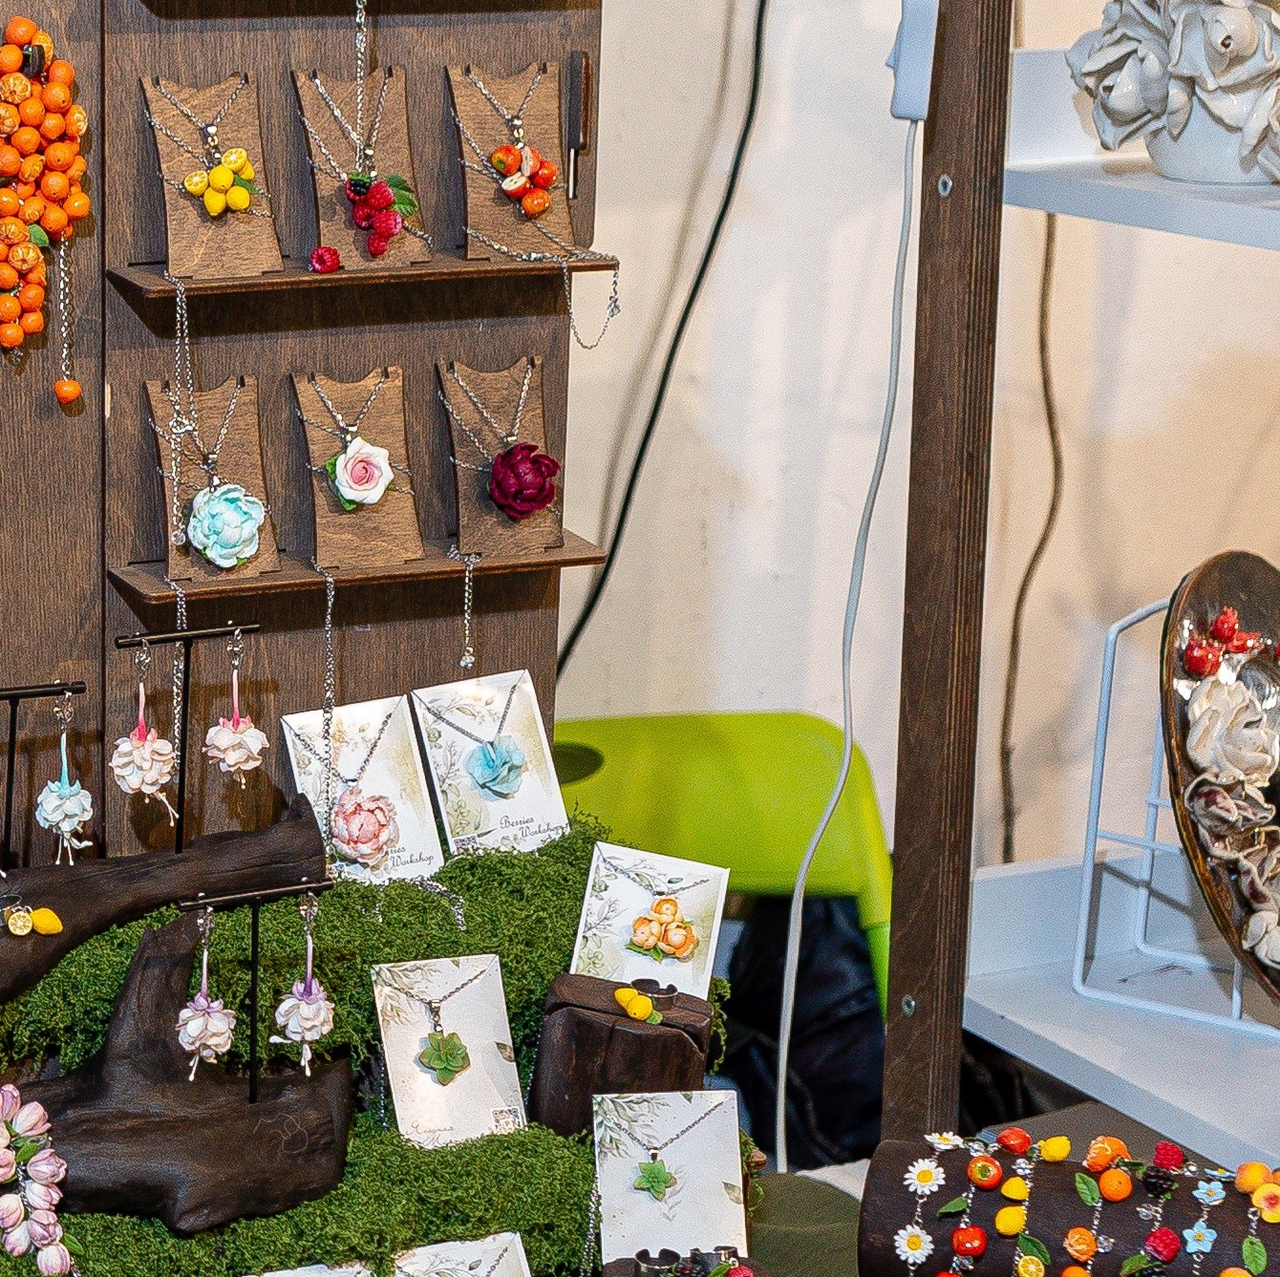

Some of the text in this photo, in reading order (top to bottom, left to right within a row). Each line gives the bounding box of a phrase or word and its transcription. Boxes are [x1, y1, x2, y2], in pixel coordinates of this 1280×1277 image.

[499, 815, 535, 829] Berries
[519, 822, 560, 838] Workshop
[390, 852, 435, 867] Workshop
